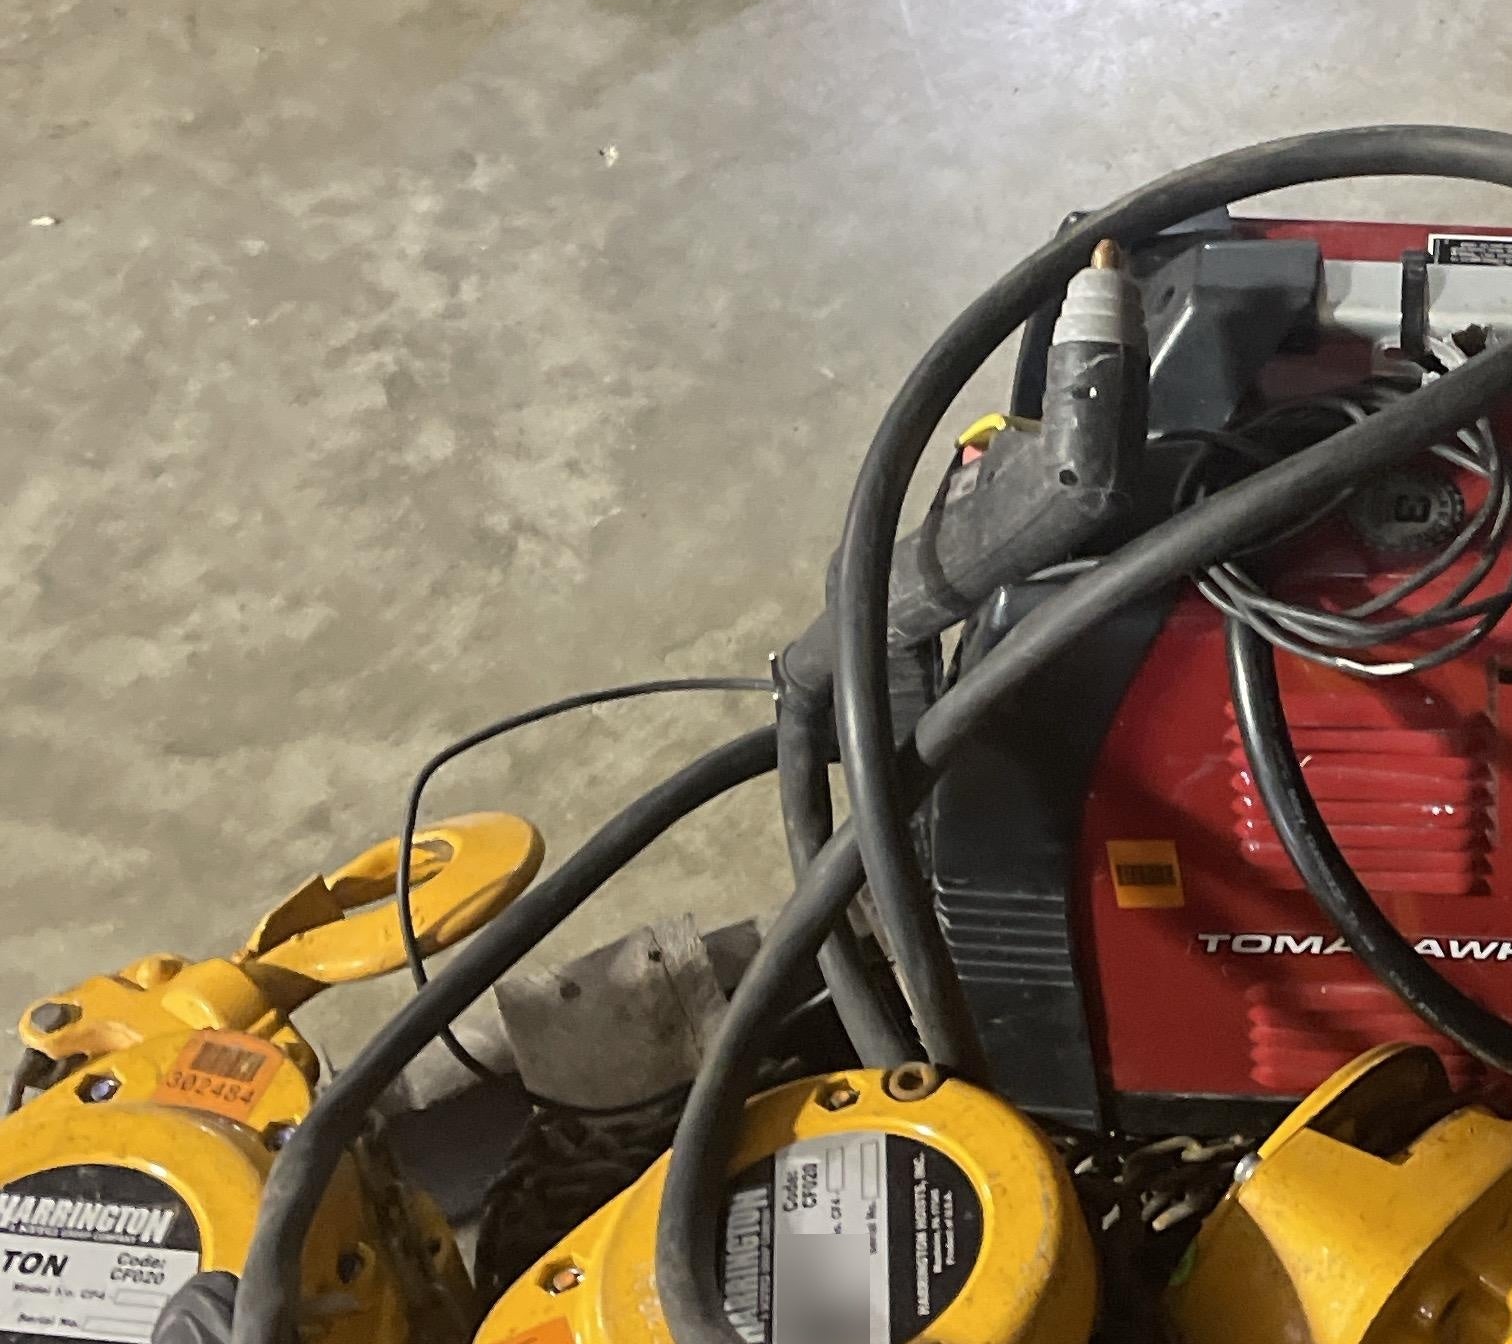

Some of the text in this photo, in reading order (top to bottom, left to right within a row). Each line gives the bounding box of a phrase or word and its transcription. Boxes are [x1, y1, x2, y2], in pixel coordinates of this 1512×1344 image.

[165, 1070, 256, 1104] 302484
[0, 1192, 175, 1244] HARRINGTON
[3, 1250, 69, 1277] TON
[117, 1252, 167, 1269] Code:
[723, 1187, 769, 1344] HARRINGTON
[916, 1230, 930, 1316] HARRINGTON
